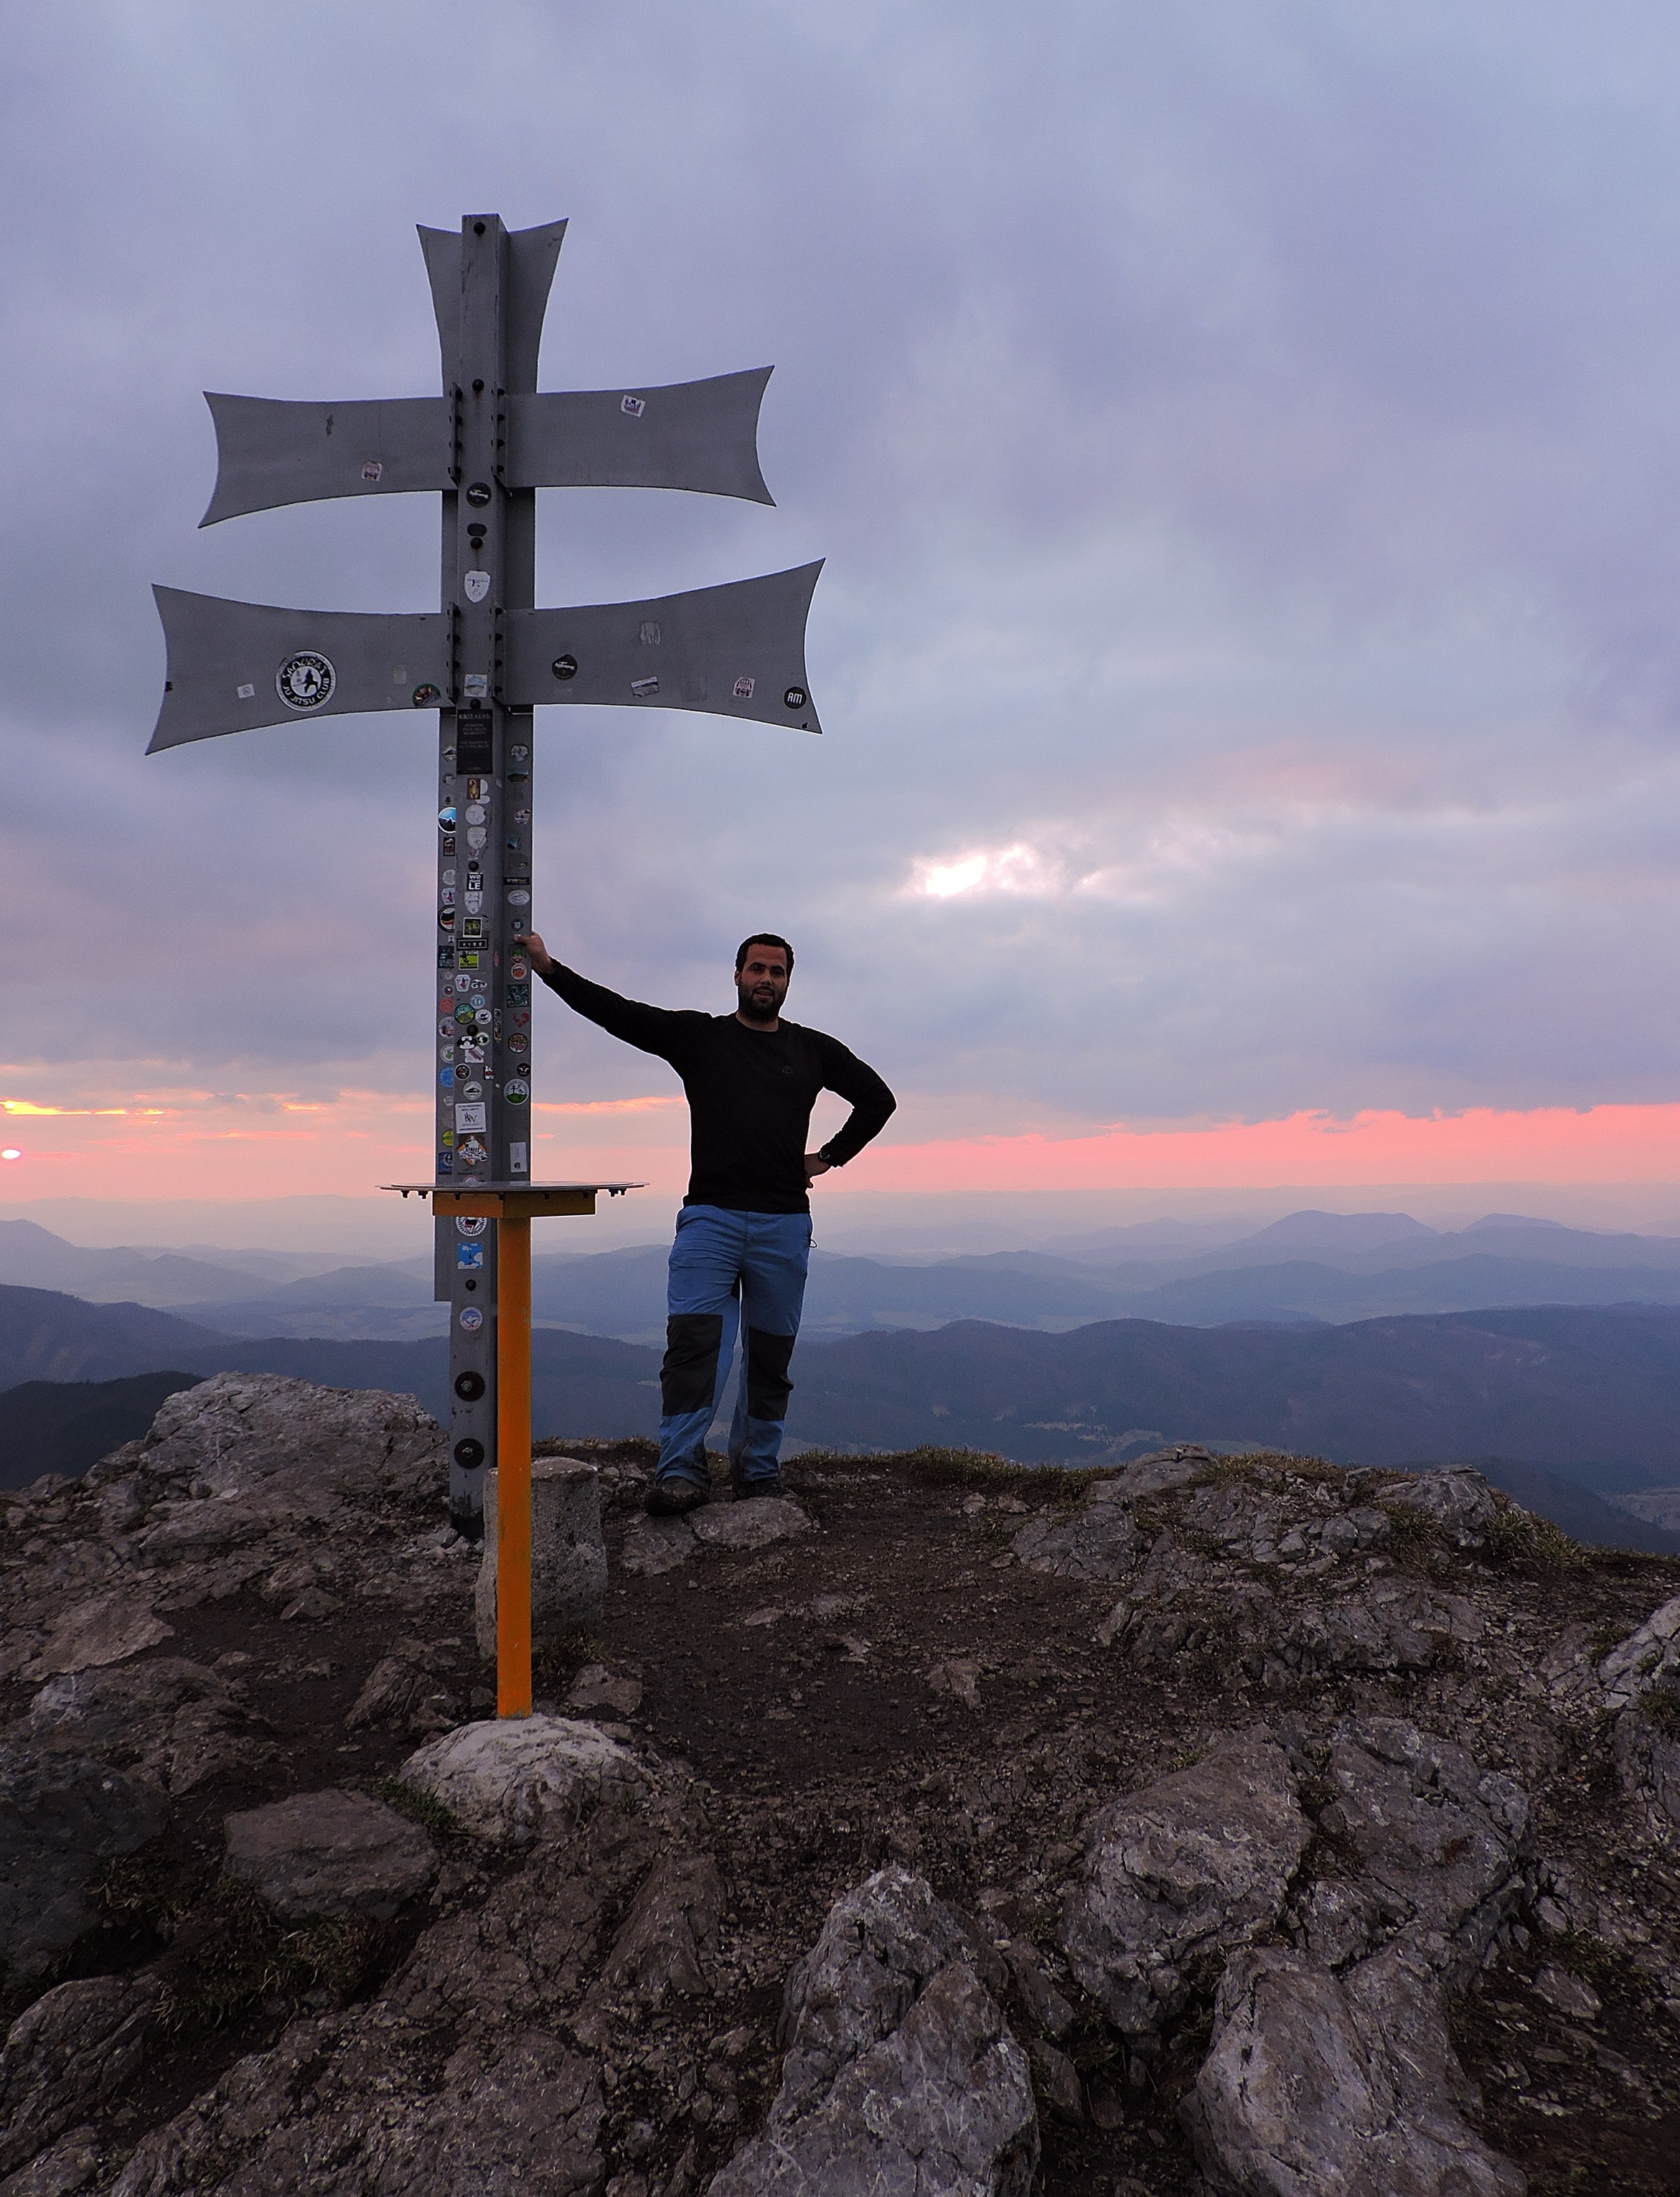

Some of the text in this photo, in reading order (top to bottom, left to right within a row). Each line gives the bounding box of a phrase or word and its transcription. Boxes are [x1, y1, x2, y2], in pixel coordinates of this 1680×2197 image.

[283, 678, 329, 705] JU JITSU CLUB
[787, 692, 802, 704] AM
